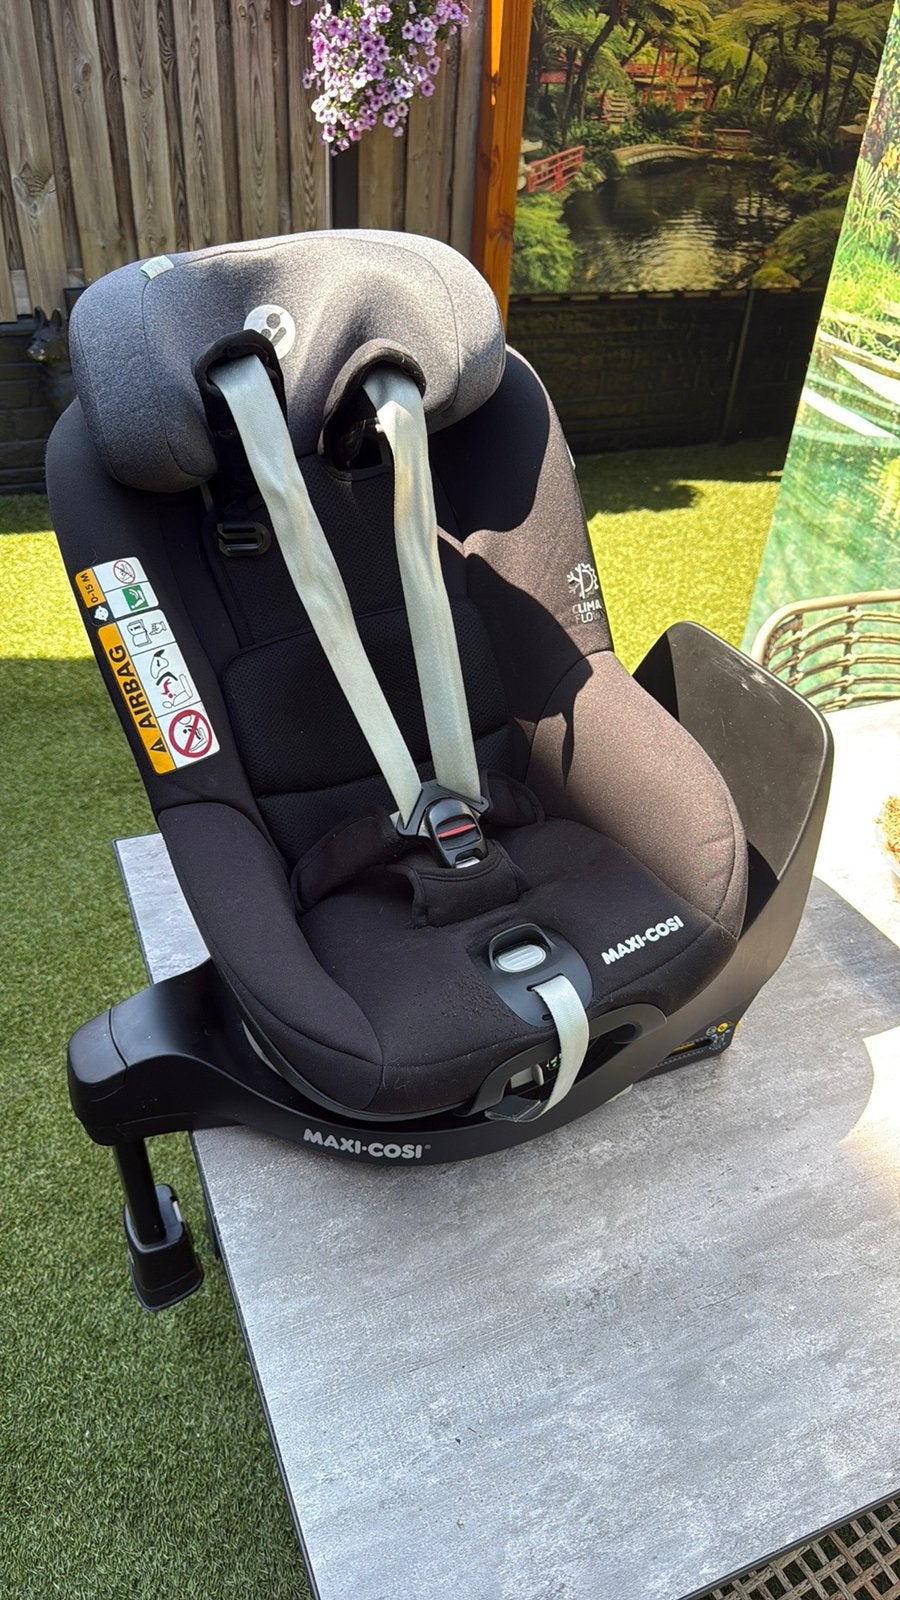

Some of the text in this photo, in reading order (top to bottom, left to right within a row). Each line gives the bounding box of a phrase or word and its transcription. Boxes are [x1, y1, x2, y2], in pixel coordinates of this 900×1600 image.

[80, 572, 99, 603] 0-15 M
[572, 600, 602, 614] CLIMA
[109, 645, 155, 729] AIRBAG
